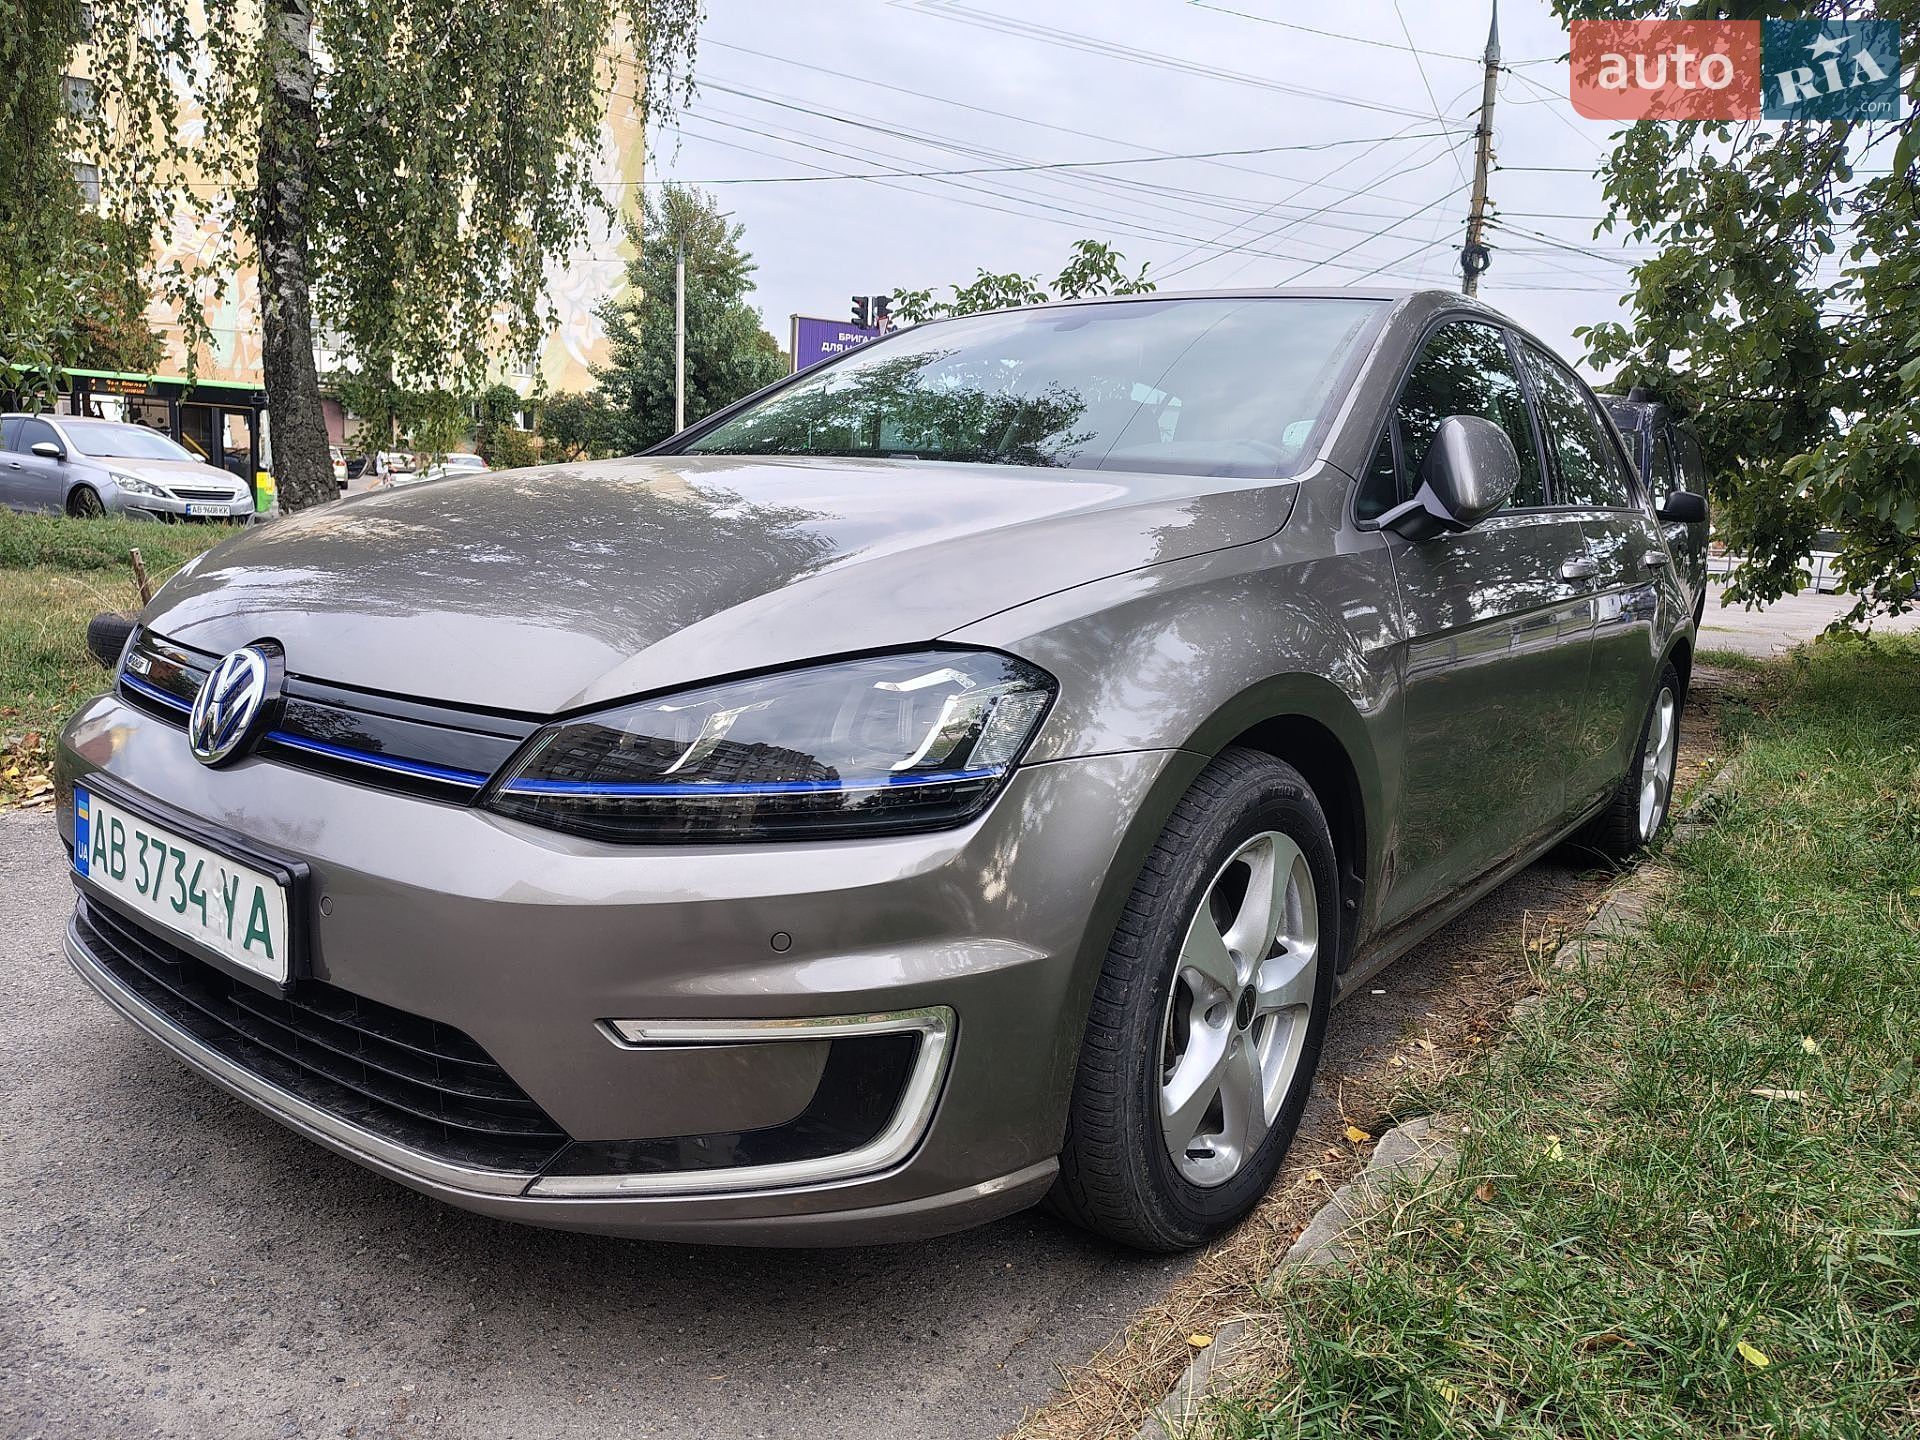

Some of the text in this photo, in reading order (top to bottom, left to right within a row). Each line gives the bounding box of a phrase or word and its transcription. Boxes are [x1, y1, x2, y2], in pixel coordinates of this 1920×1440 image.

[821, 342, 843, 353] ДЛЯ
[78, 840, 88, 862] UA
[92, 808, 275, 960] AB 3734 YA
